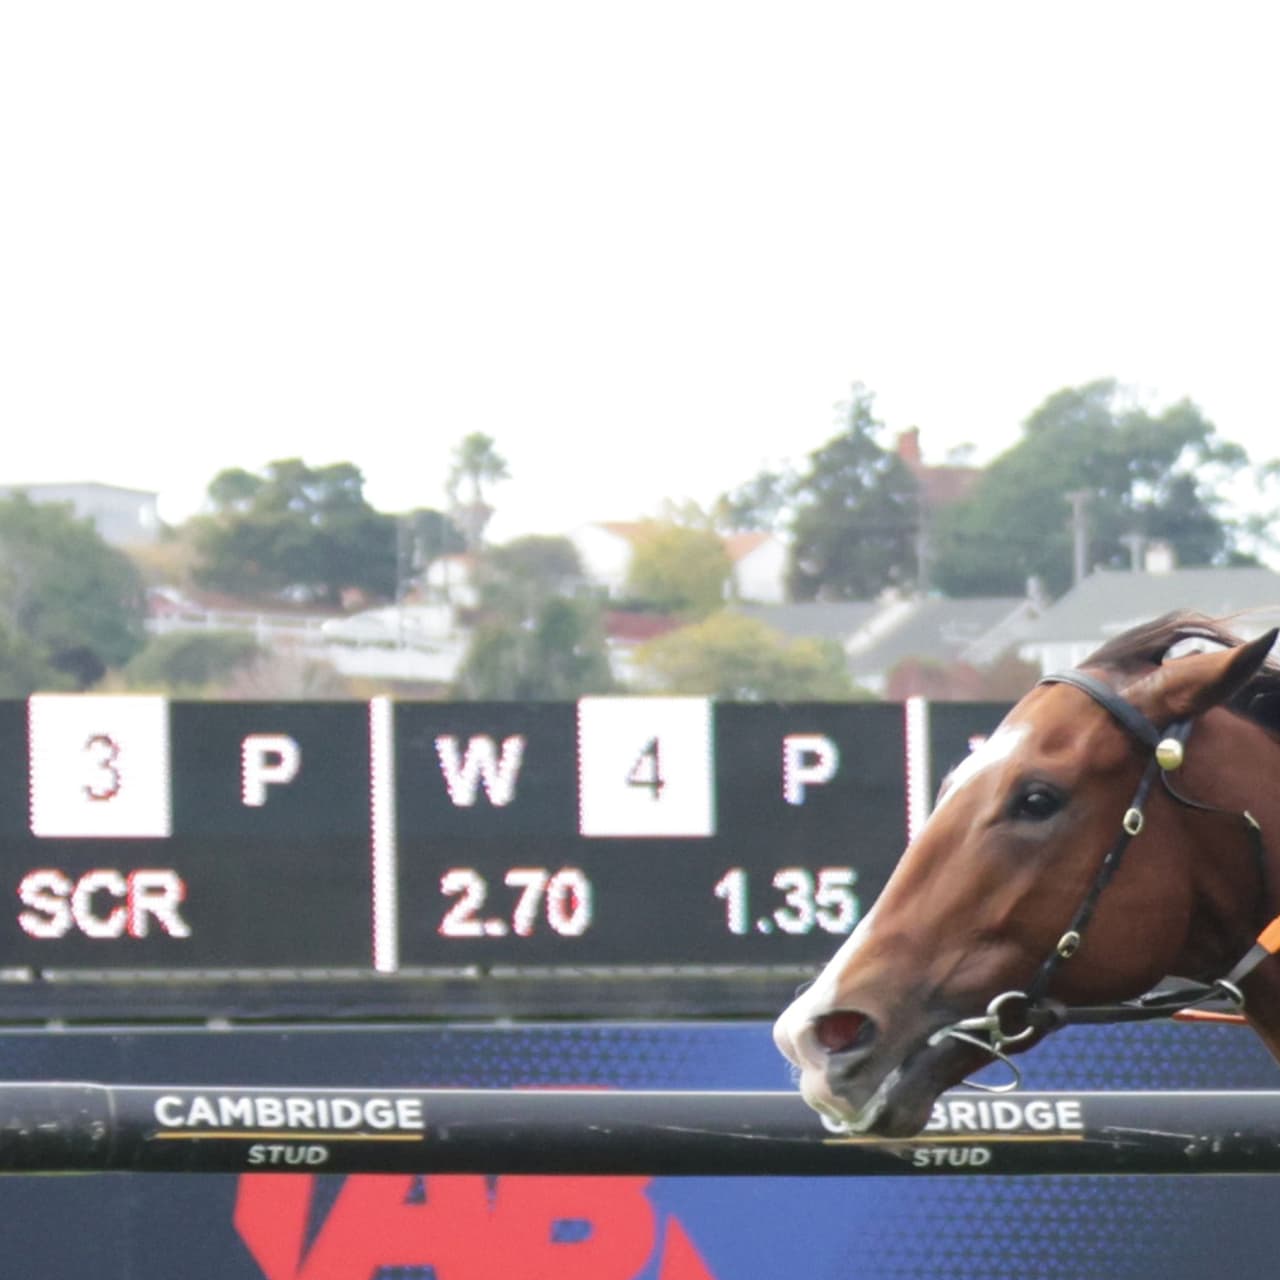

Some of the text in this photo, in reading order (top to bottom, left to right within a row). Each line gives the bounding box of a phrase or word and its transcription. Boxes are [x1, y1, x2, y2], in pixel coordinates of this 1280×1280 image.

[84, 733, 300, 807] 3 P
[435, 735, 839, 806] W 4 P
[18, 869, 190, 938] SCR
[438, 867, 858, 937] 2.70 1.35
[153, 1095, 425, 1130] CAMBRIDGE
[247, 1144, 329, 1165] STUD
[912, 1147, 992, 1168] STUD
